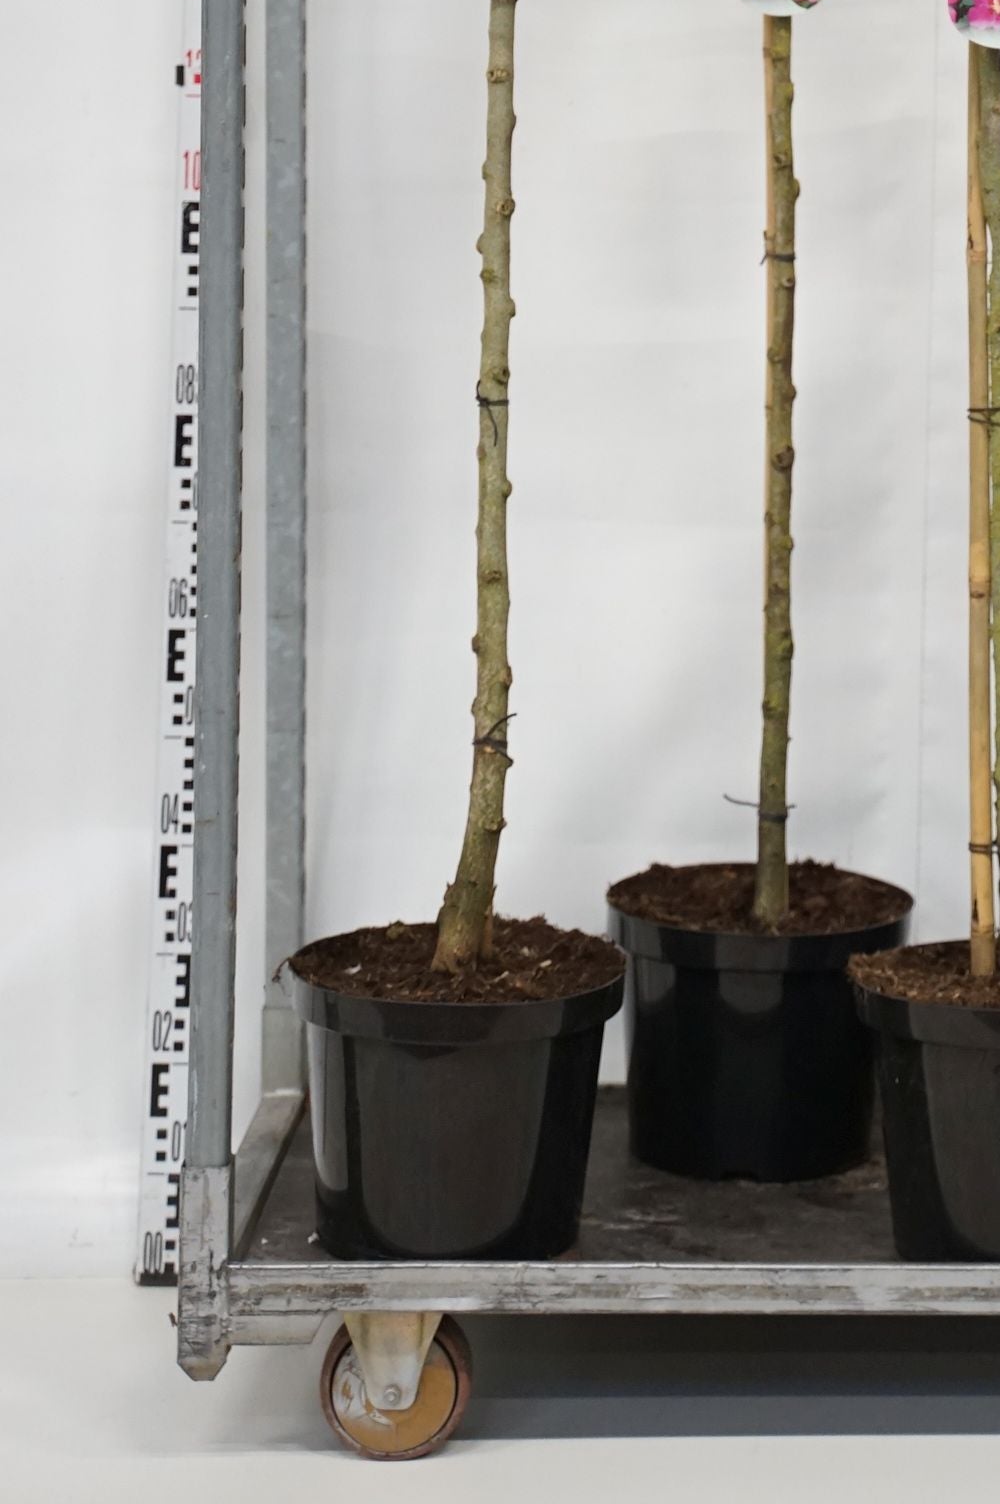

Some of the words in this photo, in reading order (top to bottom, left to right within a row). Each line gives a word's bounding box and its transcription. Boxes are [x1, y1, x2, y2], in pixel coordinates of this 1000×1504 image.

[183, 152, 200, 190] 10
[176, 364, 195, 404] 08
[168, 578, 187, 618] 06
[161, 794, 178, 834] 04
[153, 1011, 172, 1052] 02
[144, 1231, 162, 1274] 00
